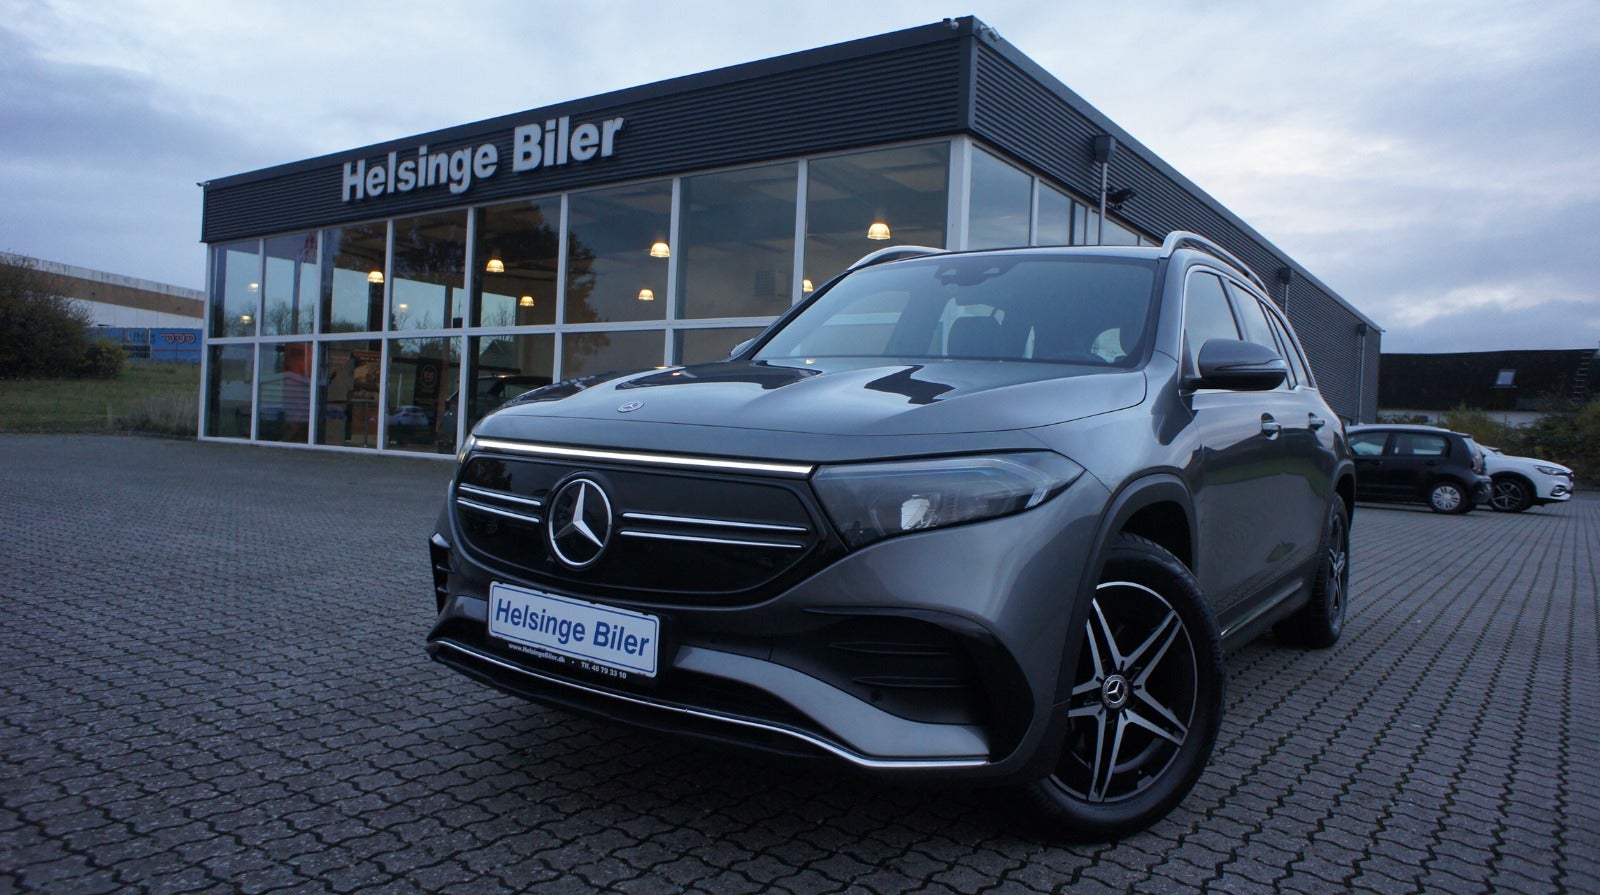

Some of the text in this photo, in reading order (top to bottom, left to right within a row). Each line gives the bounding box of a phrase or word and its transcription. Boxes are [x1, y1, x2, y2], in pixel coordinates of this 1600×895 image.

[342, 116, 624, 201] Helsinge Biler
[496, 598, 649, 657] Helsinge Biler
[618, 671, 627, 679] 10
